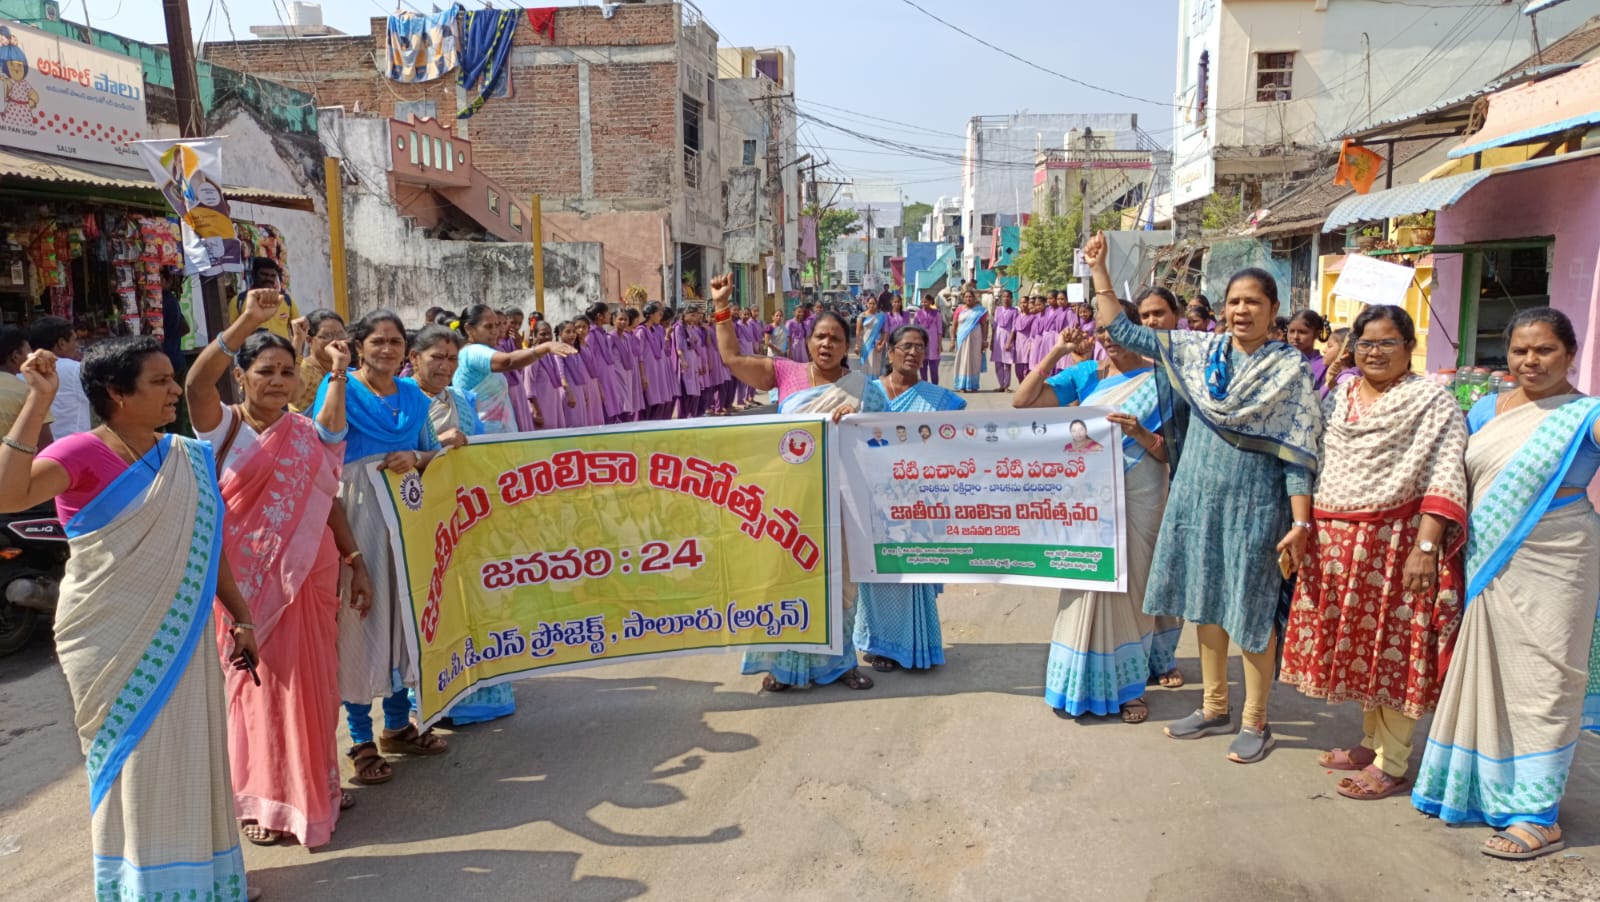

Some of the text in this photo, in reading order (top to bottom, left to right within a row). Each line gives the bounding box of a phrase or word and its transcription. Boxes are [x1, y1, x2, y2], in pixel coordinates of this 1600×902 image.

[37, 57, 91, 88] అమూల్
[94, 73, 140, 101] పాలు
[7, 125, 21, 134] PAN
[22, 127, 38, 136] SHOP
[923, 457, 977, 480] బచావో
[1027, 456, 1086, 479] పడావో
[890, 498, 1098, 526] జాతీయ బాలికా దినోత్సవం
[420, 450, 821, 644] జాతీయ బాలికా దినోత్సవం
[946, 525, 1021, 536] 24 జనవరి 2025
[482, 548, 613, 590] జనవరి
[640, 538, 704, 574] 24
[623, 604, 723, 640] సాలూరు
[727, 598, 810, 637] (అర్బన్)
